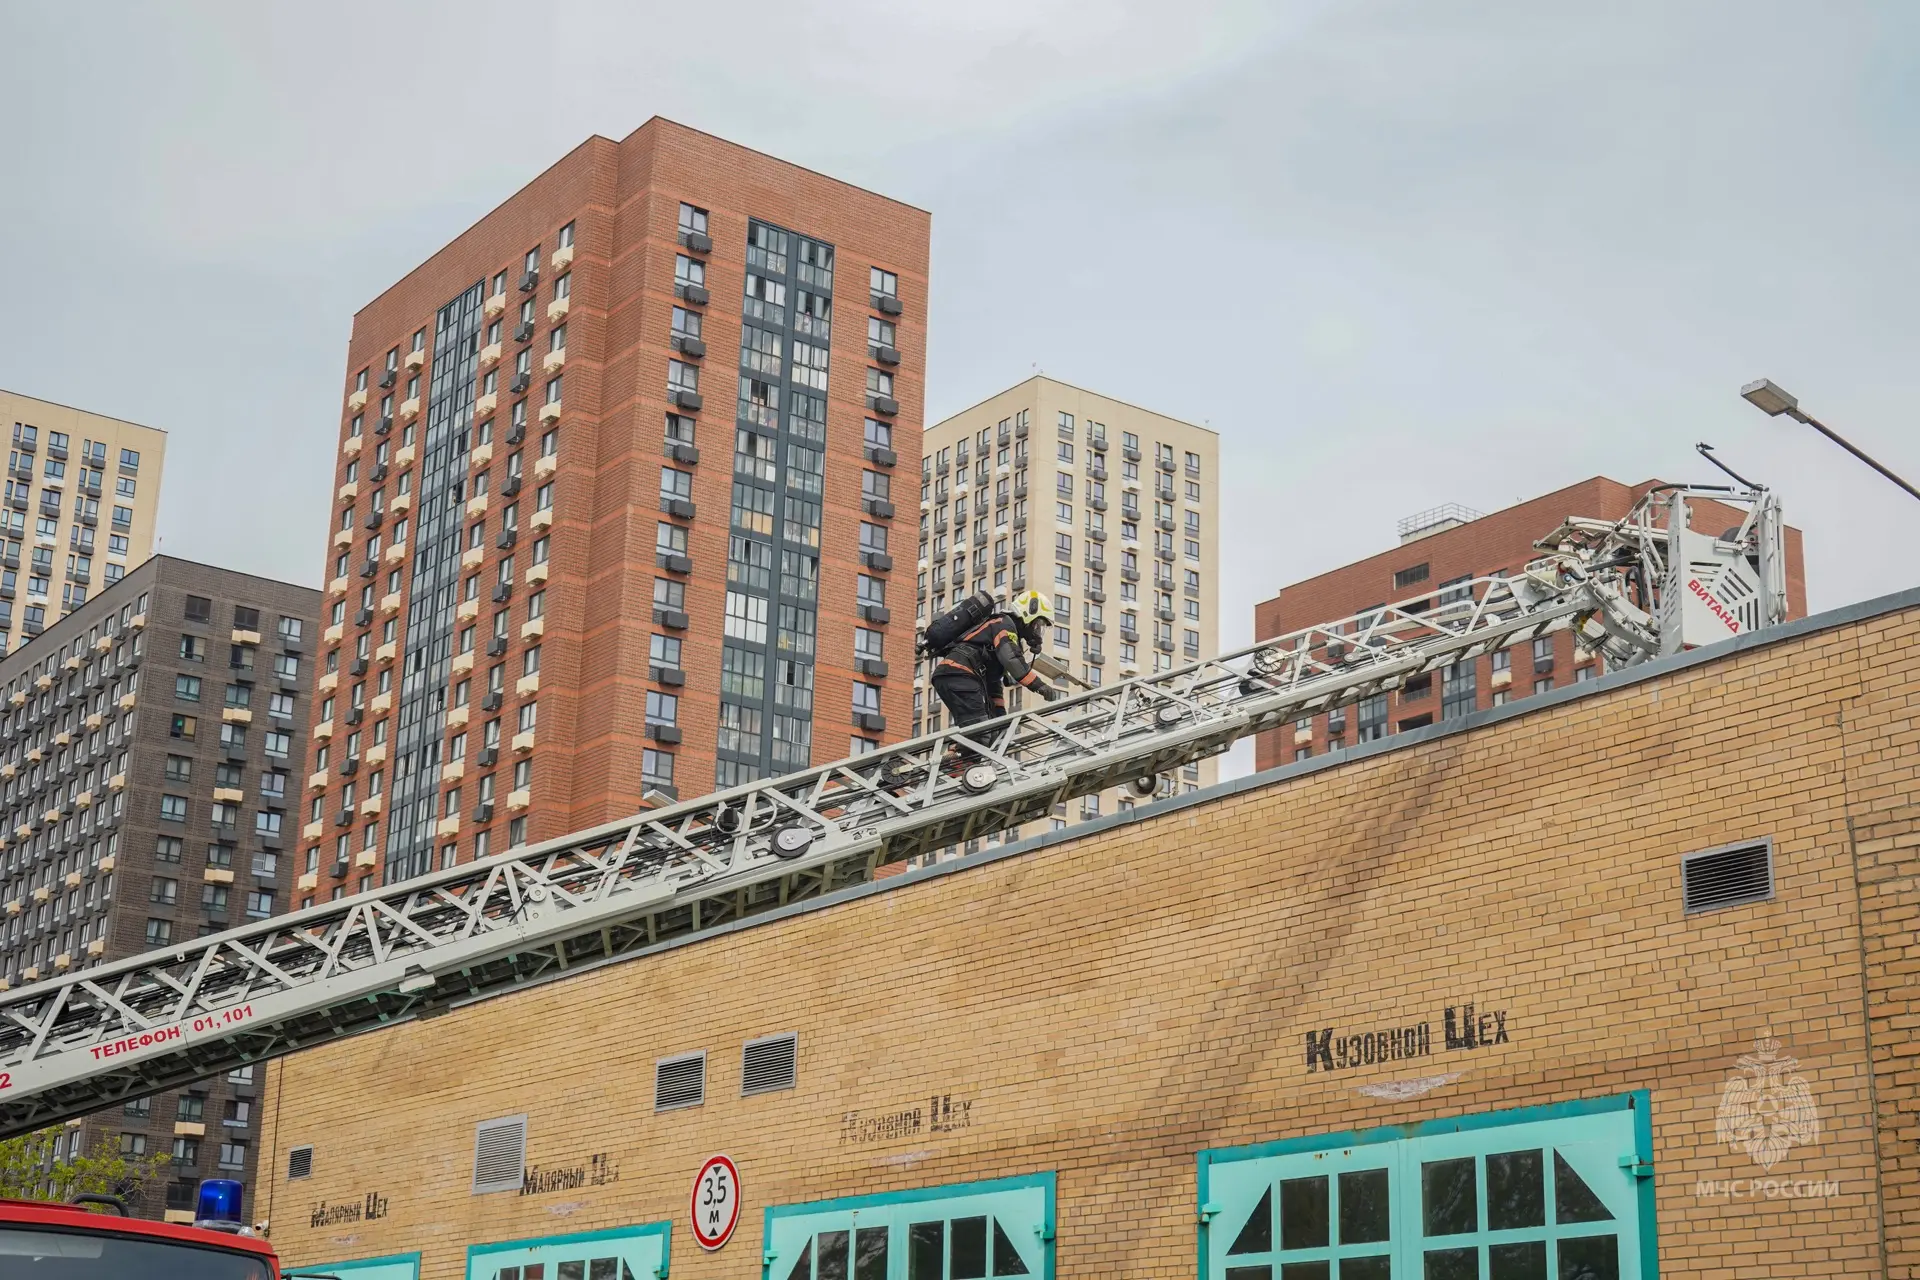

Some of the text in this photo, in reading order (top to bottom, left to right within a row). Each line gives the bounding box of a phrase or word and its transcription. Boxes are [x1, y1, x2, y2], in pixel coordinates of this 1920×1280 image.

[1687, 579, 1740, 634] ВИТАНД
[90, 1025, 181, 1060] ТЕЛЕФОН
[703, 1175, 727, 1209] 3,5
